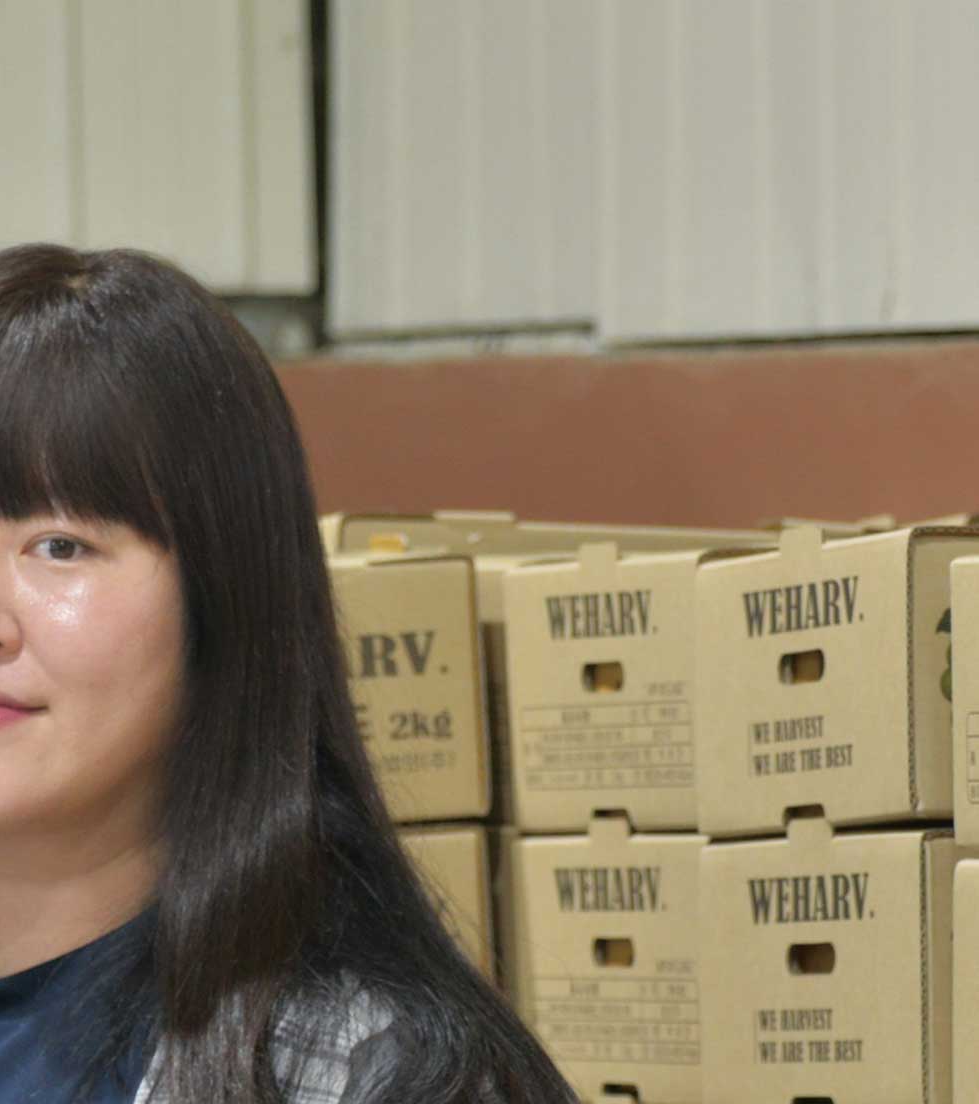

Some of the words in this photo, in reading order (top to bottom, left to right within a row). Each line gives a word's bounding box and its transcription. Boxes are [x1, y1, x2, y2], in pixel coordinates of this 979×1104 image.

[545, 590, 658, 640] WEHARV.
[743, 575, 864, 638] WEHARV.
[389, 707, 454, 742] 2kg
[747, 873, 875, 925] WEHARV.
